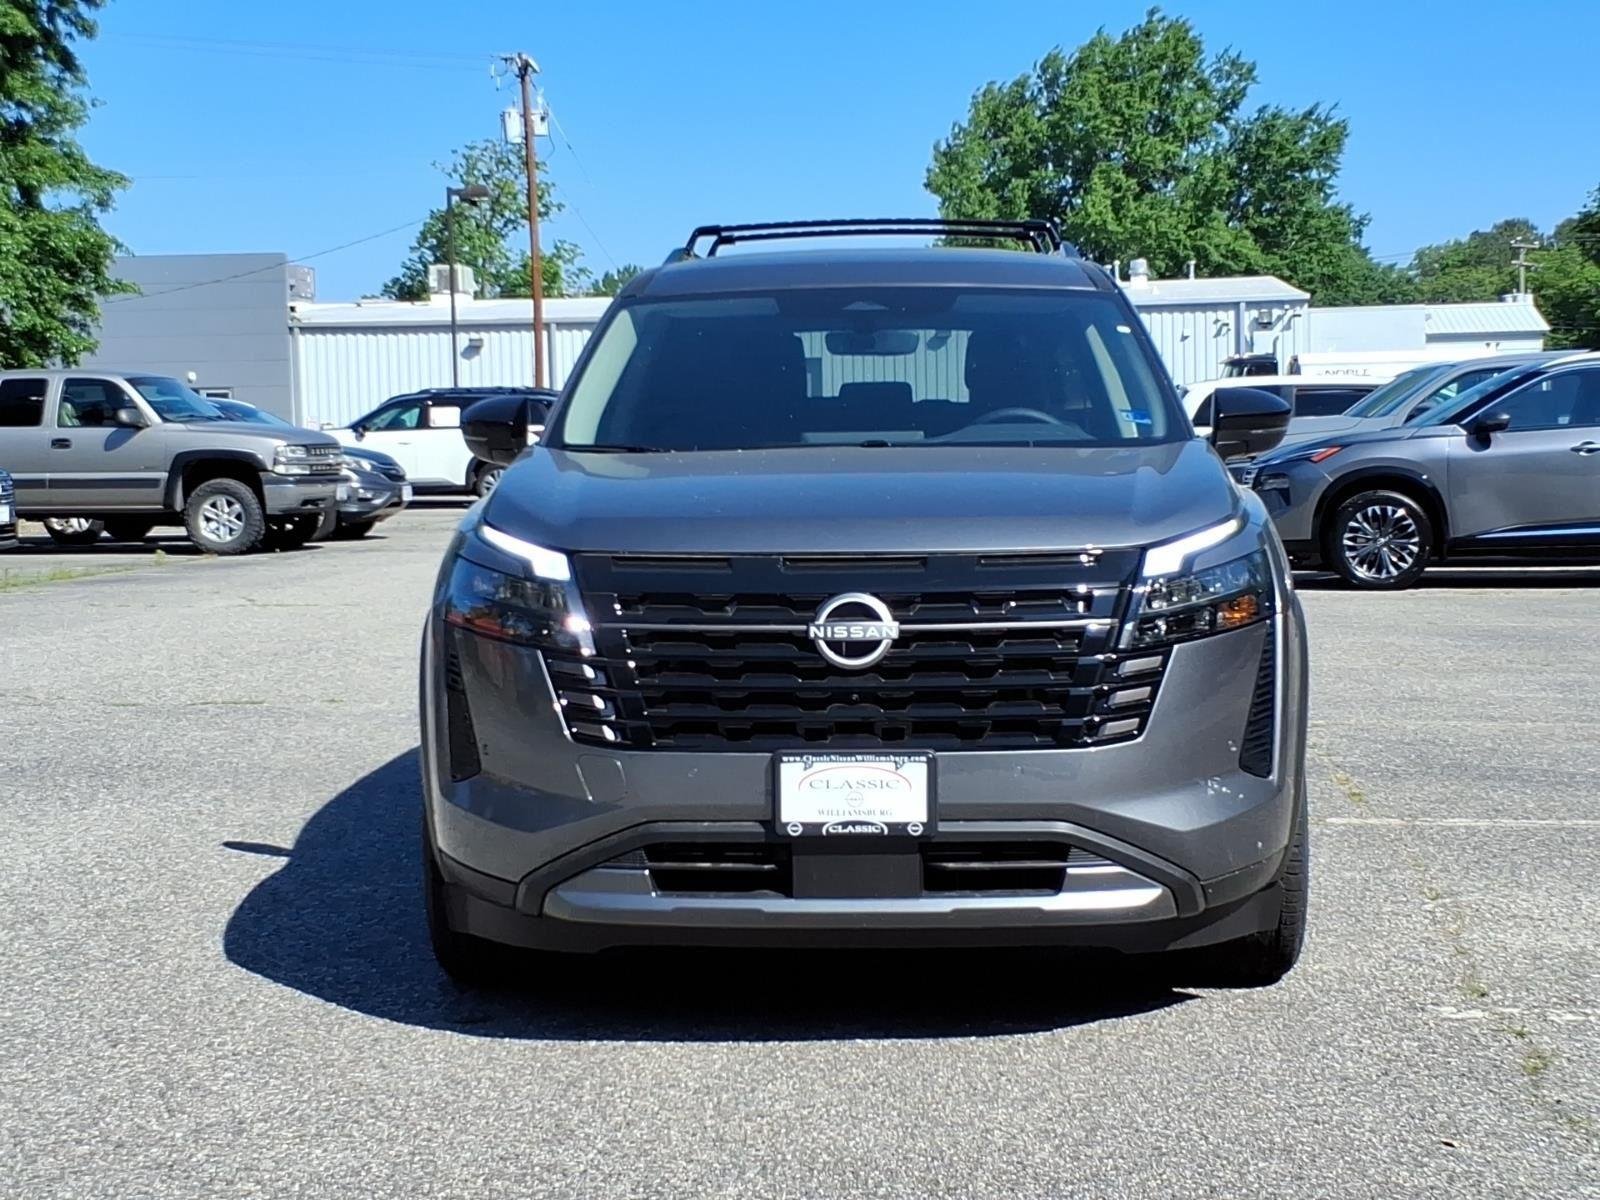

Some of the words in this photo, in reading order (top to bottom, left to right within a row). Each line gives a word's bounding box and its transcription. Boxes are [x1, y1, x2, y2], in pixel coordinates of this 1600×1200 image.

[809, 625, 897, 638] NISSAN
[808, 779, 900, 790] CLASSIC
[817, 807, 893, 817] WILLIAMSBURG
[828, 824, 881, 833] CLASSIC
